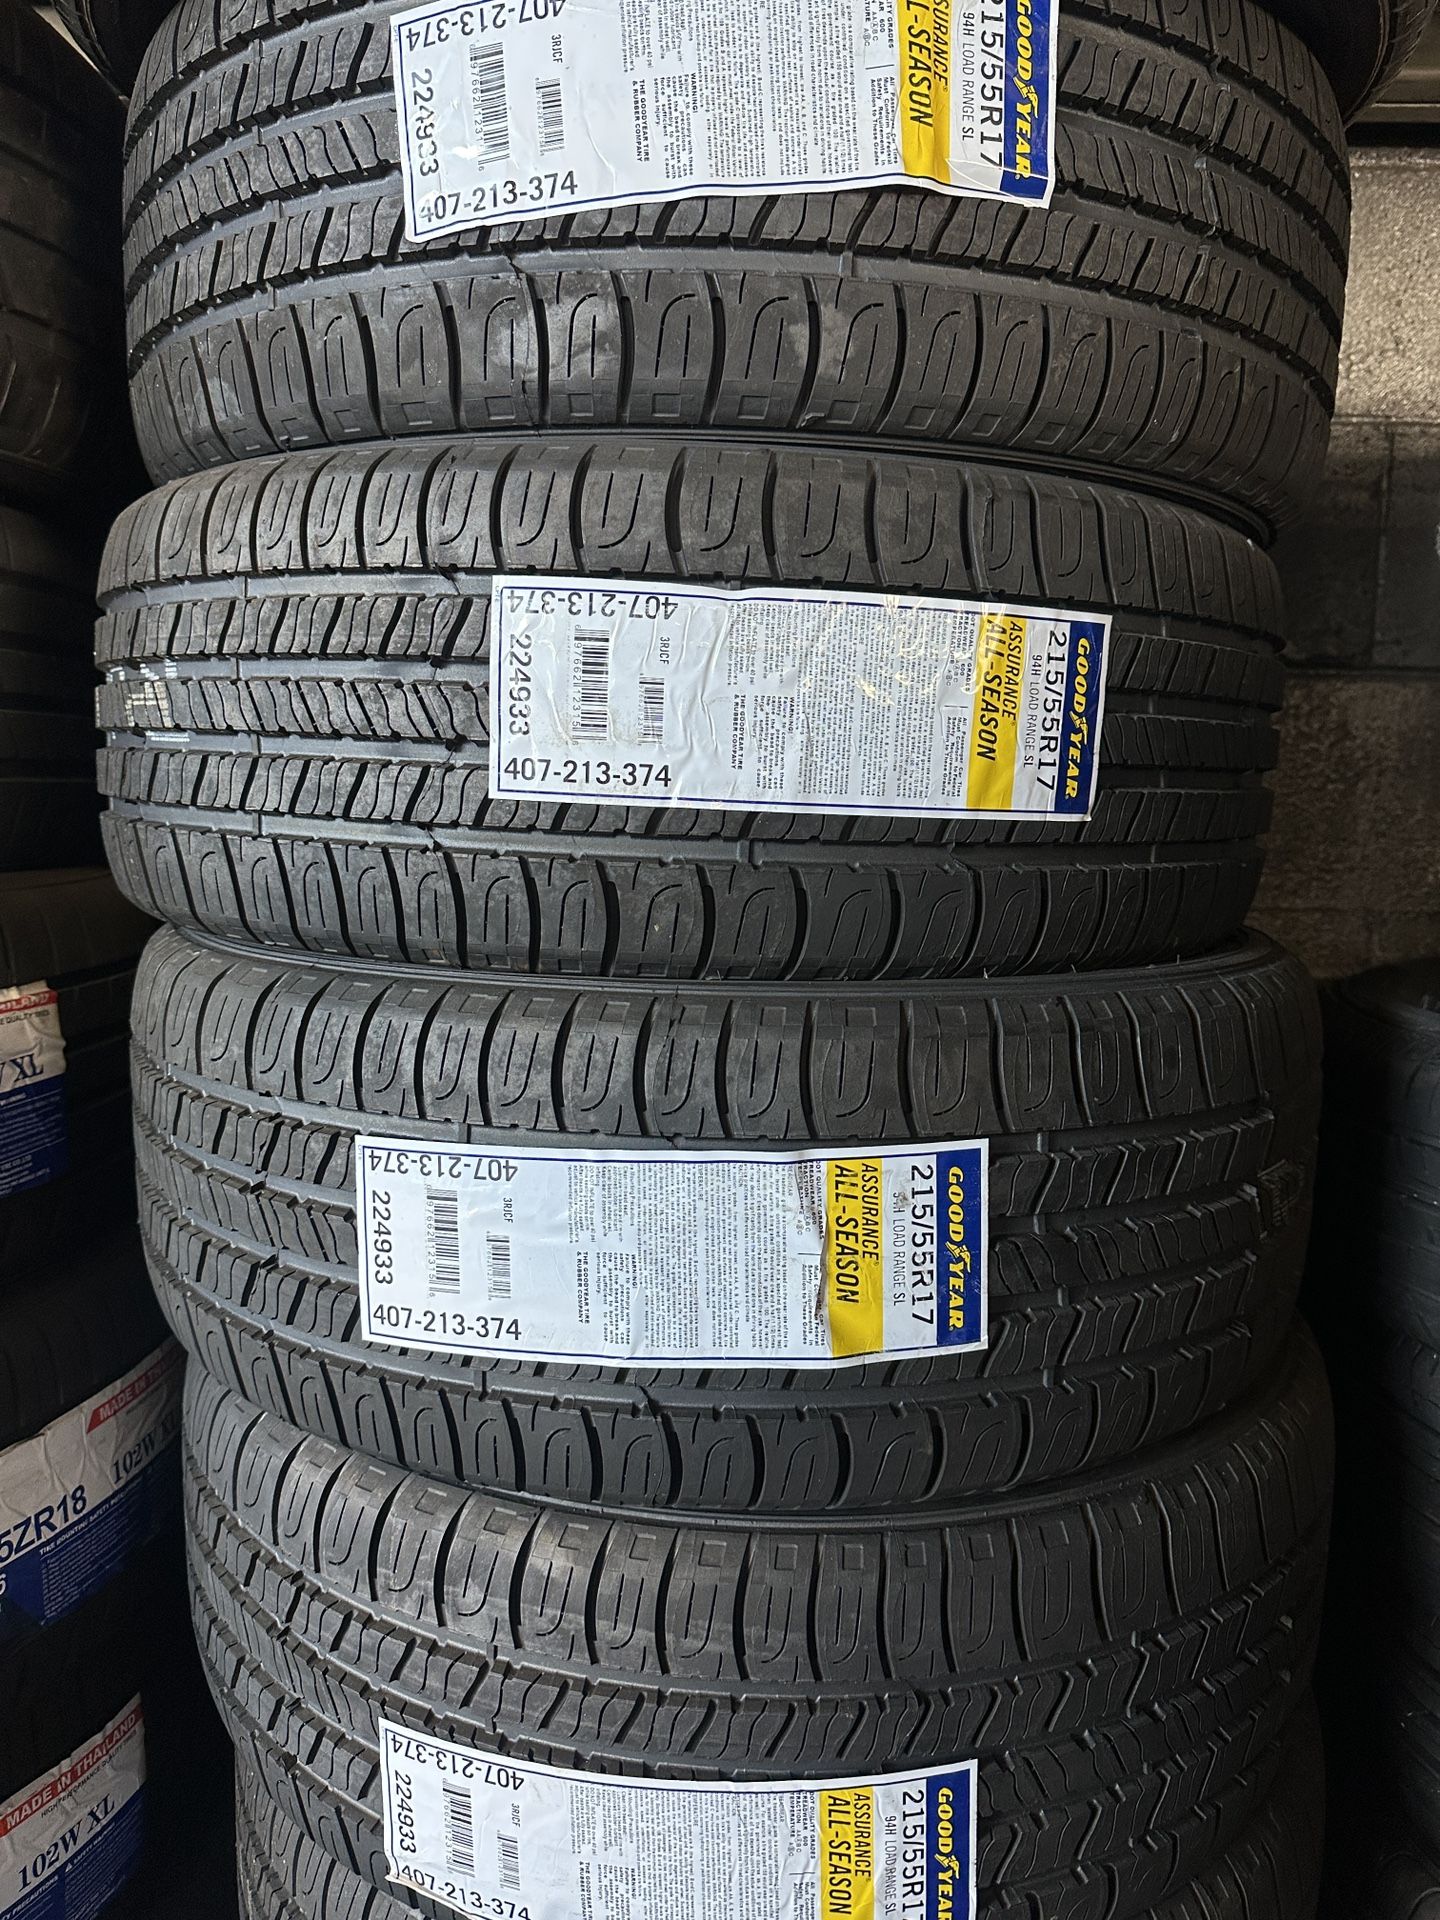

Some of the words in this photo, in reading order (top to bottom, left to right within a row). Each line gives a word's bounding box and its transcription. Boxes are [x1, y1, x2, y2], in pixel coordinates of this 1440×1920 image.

[963, 12, 974, 36] 94H
[962, 43, 974, 75] LOAD
[962, 80, 974, 122] RANGE
[962, 127, 974, 141] SL
[419, 170, 578, 222] 407-213-374
[508, 590, 678, 619] 407-213-374
[573, 643, 582, 682] 97662
[1002, 621, 1023, 720] ASSURANCE
[1031, 654, 1042, 676] 94H
[509, 634, 532, 735] 224933
[976, 619, 1007, 761] ALL-SEASON
[1028, 682, 1040, 710] LOAD
[572, 688, 582, 728] 12315
[1037, 630, 1067, 791] 215/55R17
[1065, 637, 1091, 798] GOODYEAR
[1025, 714, 1037, 751] RANGE
[504, 758, 672, 787] 407-213-374
[1023, 755, 1034, 768] SL
[10, 1052, 44, 1082] XL
[369, 1150, 517, 1182] 407-213-374
[862, 1163, 879, 1260] ASSURANCE
[372, 1191, 393, 1285] 224933
[835, 1164, 859, 1304] ALL-SEASON
[893, 1219, 905, 1247] LOAD
[911, 1164, 934, 1325] 215/55R17
[948, 1166, 964, 1328] GOODYEAR
[893, 1252, 905, 1288] RANGE
[894, 1293, 905, 1306] SL
[374, 1304, 522, 1340] 407-213-374
[99, 1389, 134, 1420] MADE
[113, 1430, 156, 1484] 102W
[6, 1789, 53, 1830] MADE
[57, 1772, 72, 1795] IN
[76, 1714, 136, 1773] THAILAND
[391, 1735, 525, 1790] 407-213-374
[395, 1770, 416, 1853] 224933
[885, 1816, 896, 1835] 94H
[18, 1819, 83, 1892] 102W
[87, 1793, 116, 1833] XL
[828, 1795, 852, 1914] ALL-SEASON
[854, 1793, 871, 1877] ASSURANCE
[885, 1841, 896, 1864] LOAD
[402, 1865, 531, 1920] 407-213-374
[885, 1868, 896, 1899] RANGE
[885, 1904, 896, 1916] SL
